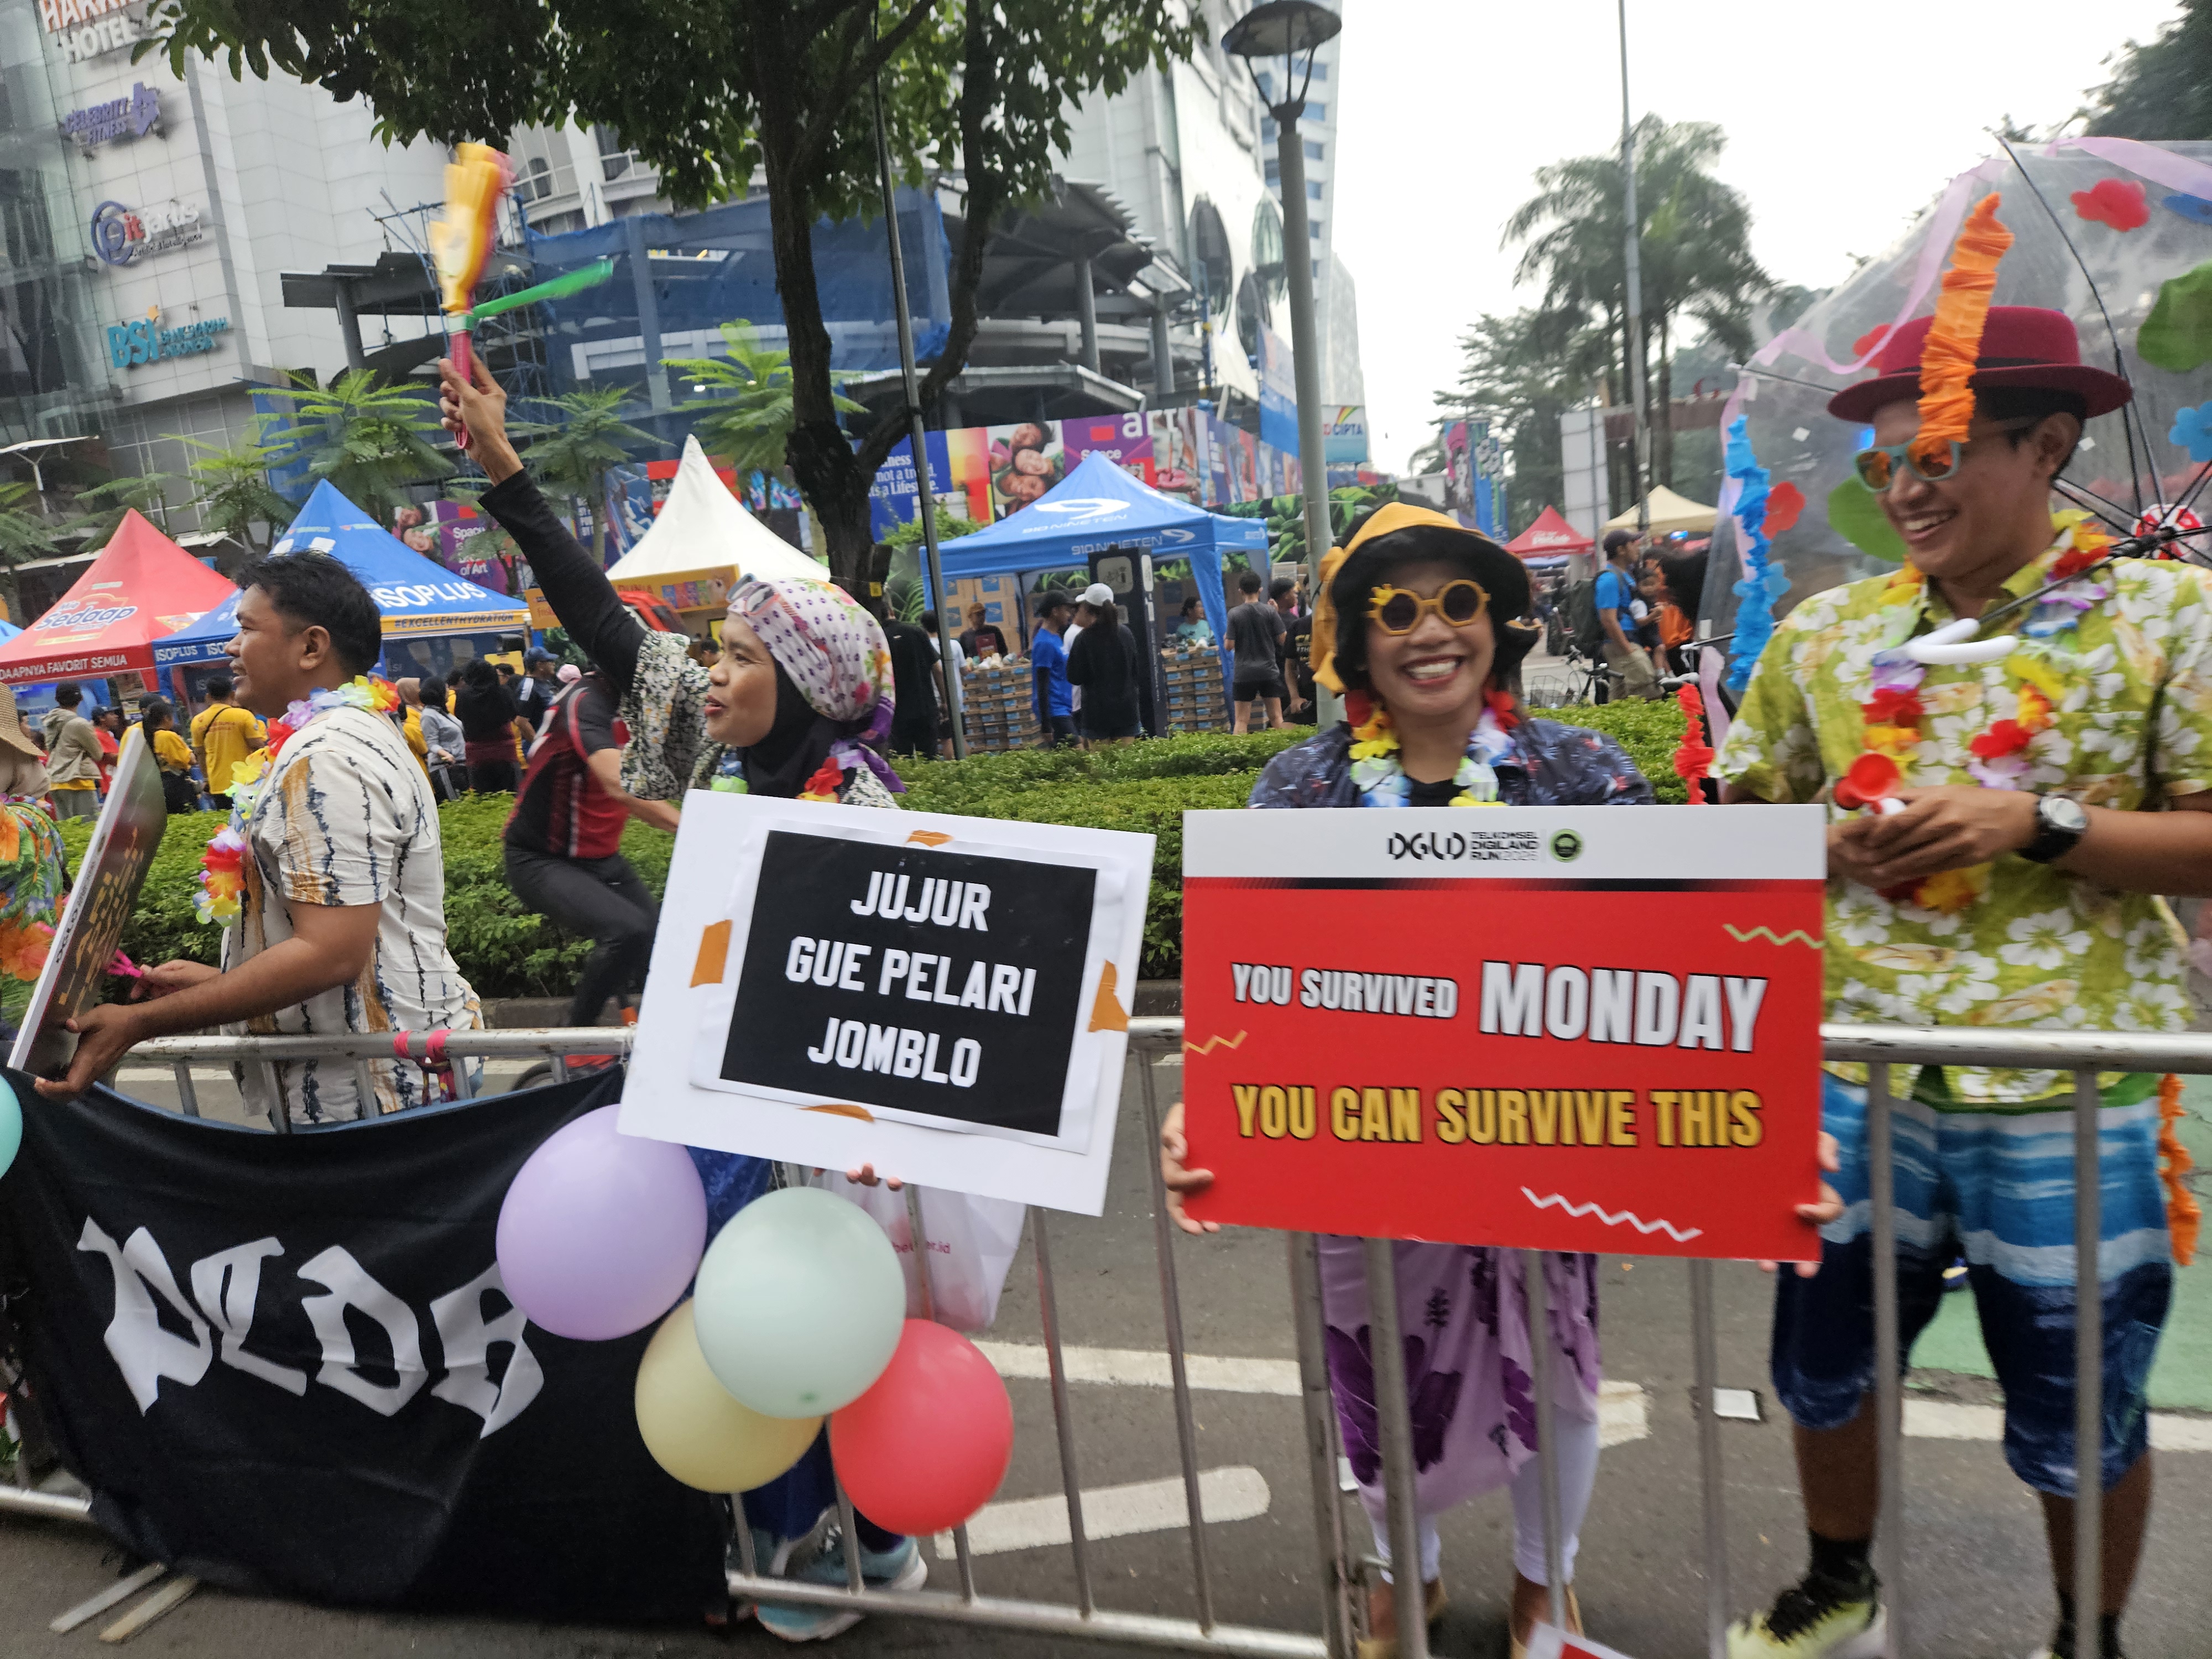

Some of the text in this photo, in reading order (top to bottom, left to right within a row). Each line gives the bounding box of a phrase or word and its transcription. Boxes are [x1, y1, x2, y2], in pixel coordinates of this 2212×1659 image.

[60, 15, 134, 64] HOTEL
[64, 97, 128, 134] CELEBRITY
[87, 118, 127, 146] FITNESS
[107, 317, 159, 368] BSI
[875, 470, 895, 482] not
[896, 470, 904, 480] a
[471, 563, 489, 575] Art
[370, 582, 487, 608] ISOPLUS
[34, 606, 138, 630] Sedaap
[394, 613, 514, 629] #EXCELLENTHYDRATION
[46, 658, 89, 674] FAVORIT
[91, 654, 128, 668] SEMUA
[155, 645, 198, 662] ISOPLUS
[1472, 840, 1539, 850] DIGILAND
[850, 870, 992, 932] JUJUR
[785, 935, 1037, 1016] GUE PELARI
[1232, 959, 1768, 1053] YOU SURVIVED MONDAY
[807, 1016, 982, 1088] JOMBLO
[1231, 1083, 1765, 1148] YOU CAN SURVIVE THIS
